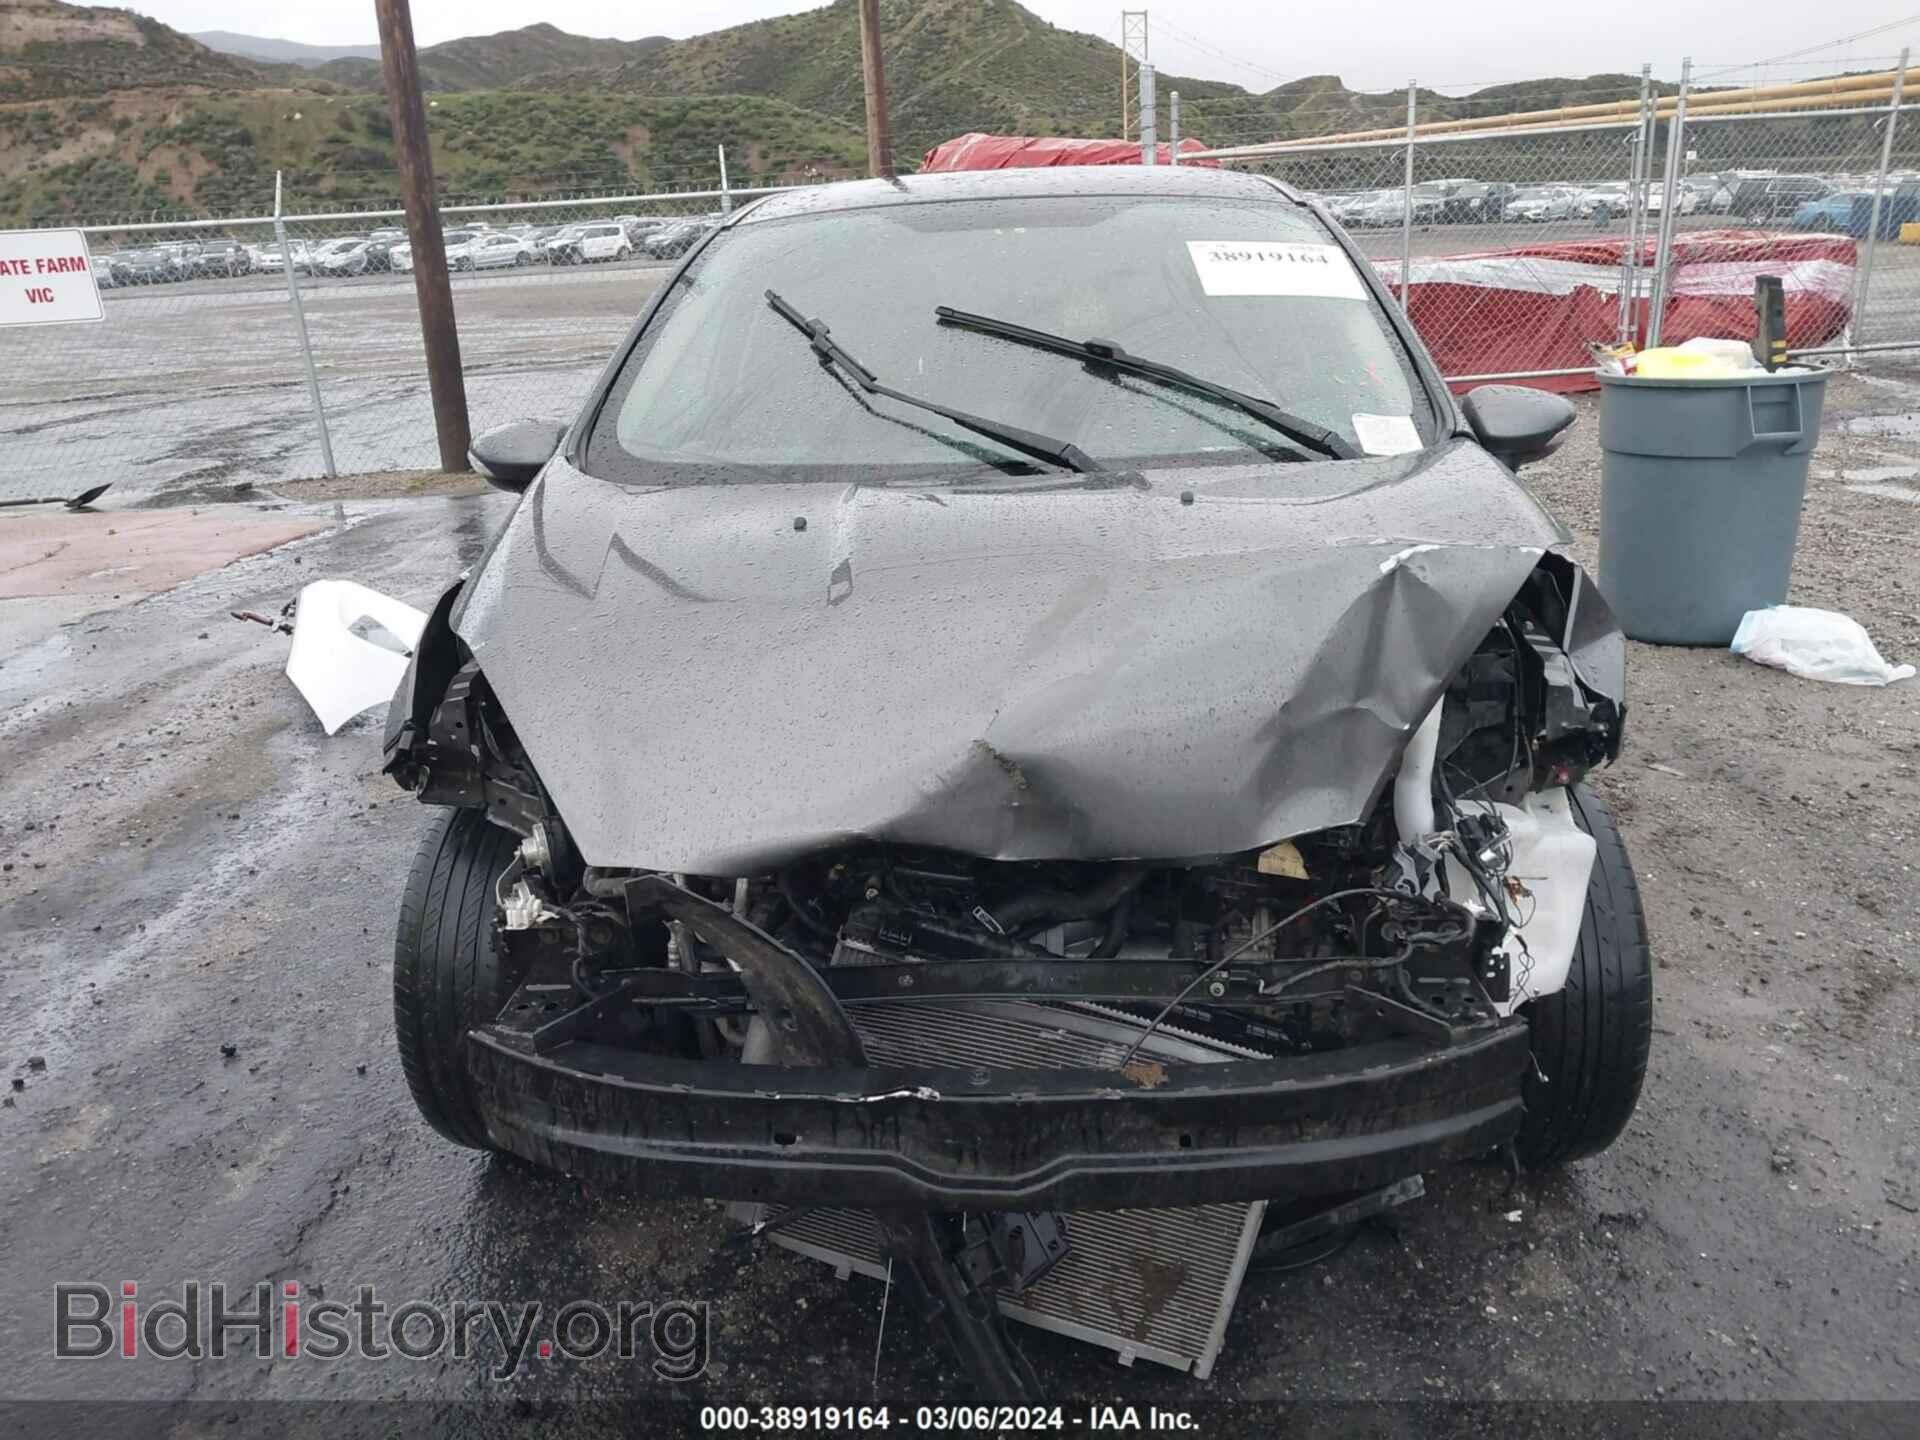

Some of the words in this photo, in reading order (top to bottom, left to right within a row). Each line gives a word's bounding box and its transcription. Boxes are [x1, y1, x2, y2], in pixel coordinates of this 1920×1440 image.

[0, 259, 32, 276] ATE
[35, 256, 86, 274] FARM
[1208, 250, 1329, 265] 38919164
[24, 287, 55, 304] VIC
